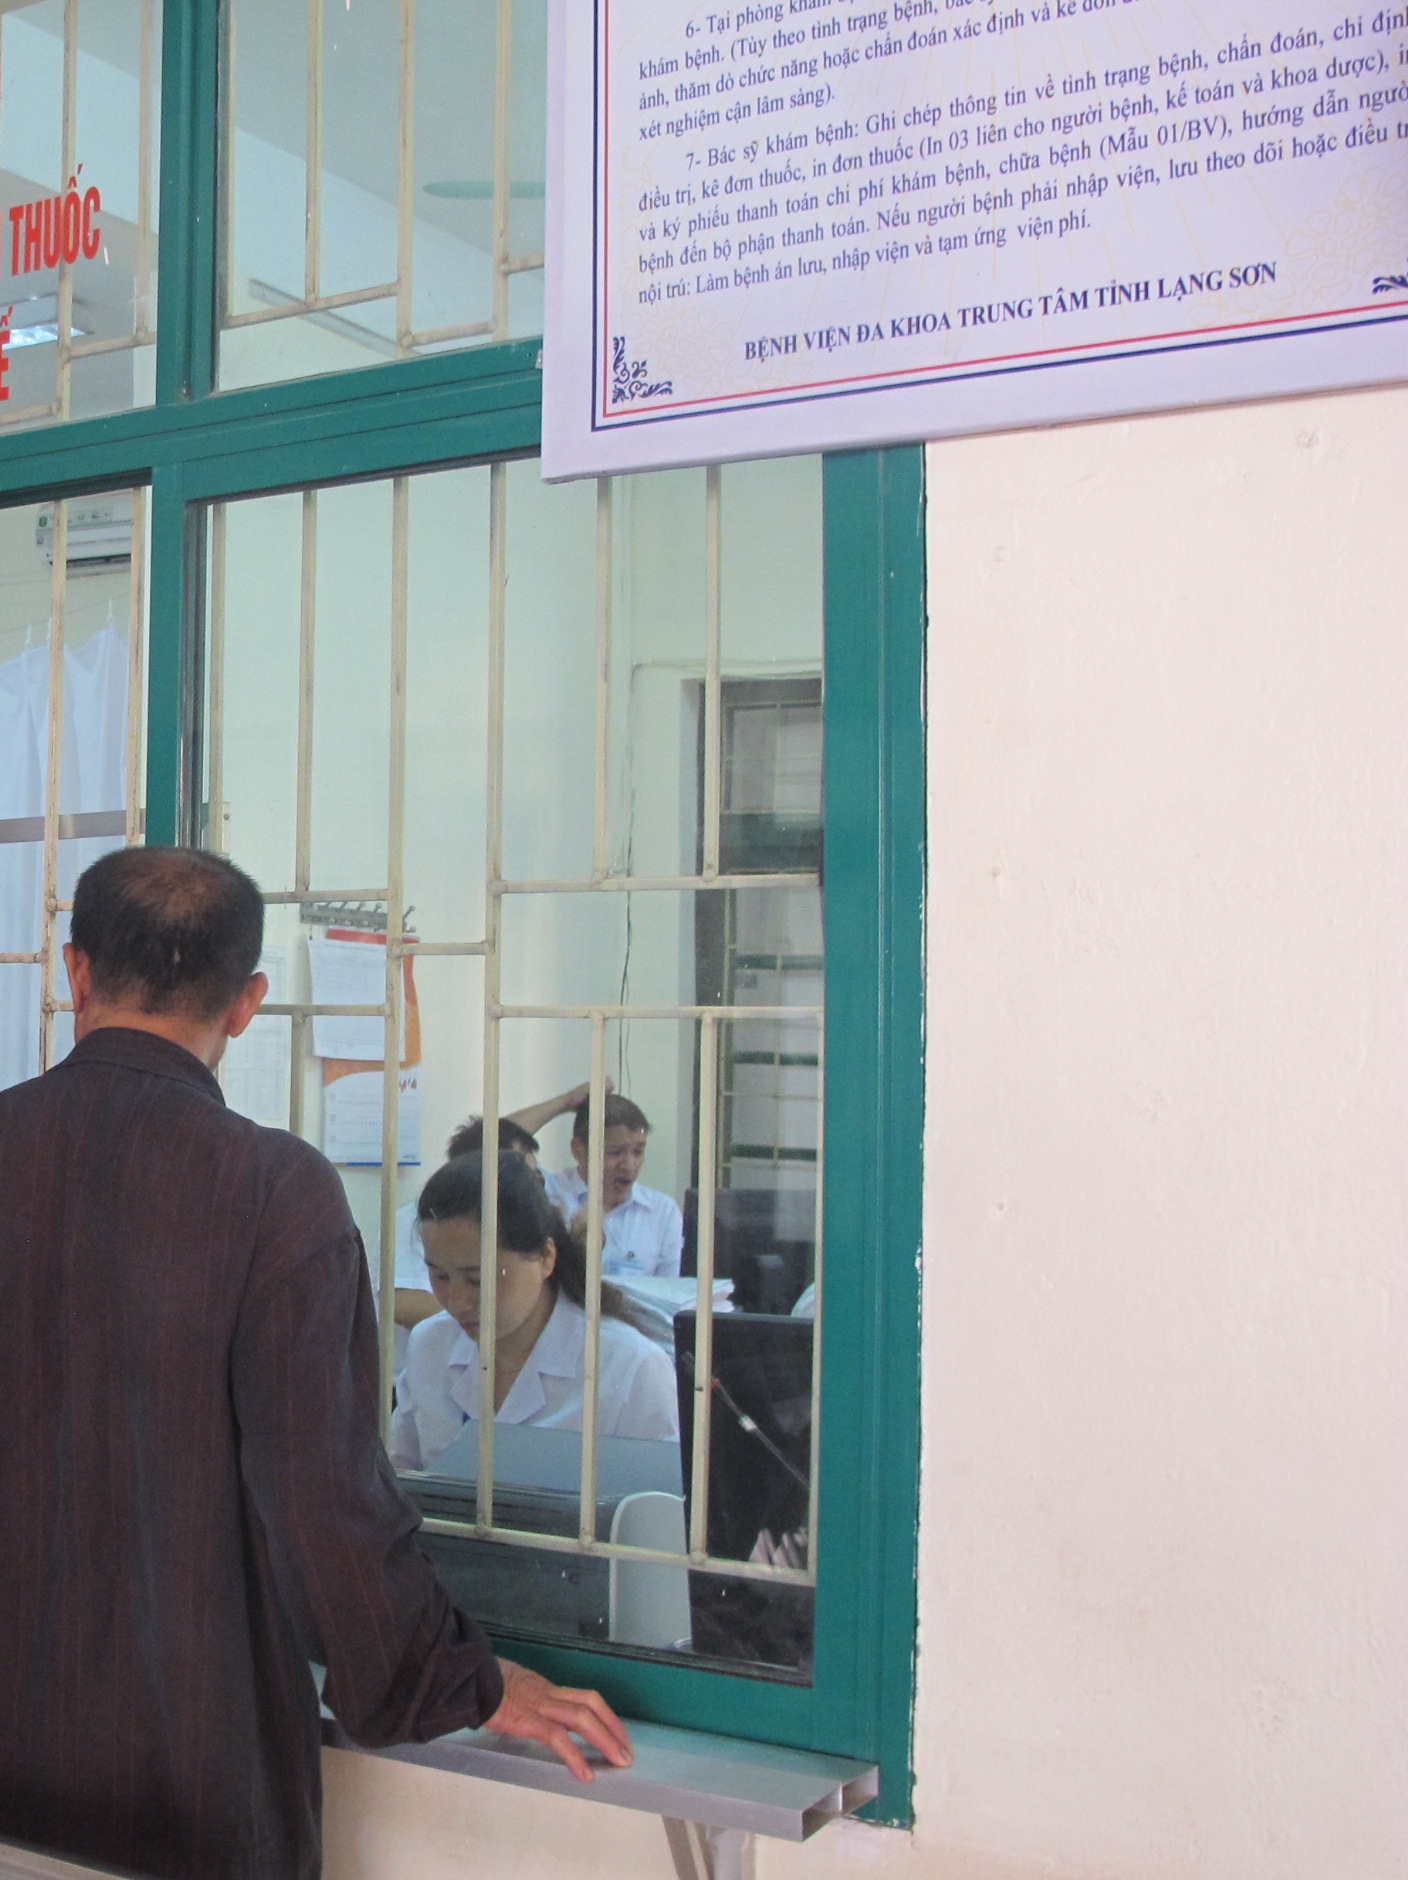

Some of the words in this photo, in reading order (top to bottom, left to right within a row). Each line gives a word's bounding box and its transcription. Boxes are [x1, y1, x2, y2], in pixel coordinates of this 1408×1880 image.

[638, 56, 680, 81] khám
[684, 44, 725, 72] bệnh.
[729, 35, 768, 62] (Tùy
[771, 28, 807, 50] theo
[810, 16, 842, 41] tình
[846, 10, 889, 34] trạng
[638, 87, 670, 112] ảnh,
[674, 81, 711, 103] thăm
[714, 71, 736, 94] dò
[738, 64, 776, 89] chức
[780, 58, 819, 80] năng
[822, 46, 860, 70] hoặc
[863, 30, 904, 61] chẩn
[906, 25, 948, 52] đoán
[952, 18, 982, 42] xác
[986, 7, 1025, 35] định
[1030, 1, 1051, 24] và
[684, 19, 702, 40] 6-
[705, 10, 731, 36] Tại
[735, 2, 785, 33] phòng
[637, 184, 671, 213] điều
[674, 182, 697, 207] trị,
[701, 178, 720, 200] kê
[723, 174, 754, 196] đơn
[758, 158, 807, 189] thuốc,
[812, 157, 828, 179] in
[831, 152, 864, 175] đơn
[868, 135, 914, 168] thuốc
[918, 135, 944, 161] (In
[948, 128, 970, 152] 03
[975, 123, 1008, 147] liên
[1012, 116, 1046, 140] cho
[1050, 101, 1103, 136] người
[1109, 92, 1160, 123] bệnh,
[1165, 79, 1188, 111] kế
[1193, 79, 1236, 106] toán
[1241, 71, 1265, 96] và
[1270, 65, 1319, 91] khoa
[1324, 49, 1390, 81] dược),
[638, 119, 662, 142] xét
[665, 108, 721, 139] nghiệm
[724, 100, 752, 125] cận
[756, 94, 785, 116] lâm
[789, 82, 836, 109] sàng).
[685, 151, 702, 171] 7-
[707, 144, 737, 168] Bác
[742, 139, 760, 164] sỹ
[765, 131, 809, 156] khám
[814, 119, 859, 147] bệnh:
[865, 109, 897, 135] Ghi
[902, 102, 943, 128] chép
[948, 93, 998, 119] thông
[1003, 85, 1027, 108] tin
[1034, 72, 1056, 101] về
[1061, 69, 1097, 96] tình
[1103, 64, 1151, 89] trạng
[1157, 48, 1209, 79] bệnh,
[1216, 32, 1263, 66] chẩn
[1269, 26, 1325, 55] đoán,
[8, 162, 103, 277] THUỐC
[638, 221, 657, 242] và
[662, 216, 682, 242] ký
[687, 203, 730, 239] phiếu
[735, 197, 779, 224] thanh
[785, 191, 820, 215] toán
[825, 183, 851, 208] chi
[857, 177, 884, 208] phí
[891, 170, 937, 196] khám
[944, 158, 992, 188] bệnh,
[998, 151, 1041, 176] chữa
[1048, 138, 1092, 169] bệnh
[1098, 125, 1149, 161] (Mẫu
[1156, 114, 1233, 147] 01/BV),
[1241, 103, 1305, 132] hướng
[1311, 88, 1350, 119] dẫn
[638, 249, 675, 276] bệnh
[678, 239, 708, 266] đến
[712, 238, 733, 262] bộ
[737, 232, 776, 261] phận
[781, 221, 825, 248] thanh
[830, 215, 871, 239] toán.
[876, 201, 911, 231] Nếu
[916, 195, 966, 228] người
[972, 187, 1014, 216] bệnh
[1020, 178, 1059, 212] phải
[1065, 172, 1110, 199] nhập
[1115, 163, 1161, 190] viện,
[1168, 157, 1199, 180] lưu
[1205, 150, 1247, 174] theo
[1252, 138, 1284, 166] dõi
[1291, 132, 1338, 160] hoặc
[1344, 116, 1389, 150] điều
[638, 281, 662, 306] nội
[665, 277, 691, 300] trú:
[695, 272, 730, 294] Làm
[733, 263, 770, 290] bệnh
[773, 260, 793, 281] án
[797, 256, 828, 277] lưu,
[831, 247, 871, 272] nhập
[874, 240, 910, 265] viện
[914, 234, 934, 256] và
[937, 233, 969, 256] tạm
[973, 225, 1008, 249] ứng
[1016, 215, 1054, 241] viện
[1058, 207, 1092, 239] phí.
[744, 333, 798, 364] BỆNH
[802, 325, 852, 354] VIỆN
[855, 321, 886, 345] ĐA
[889, 311, 953, 339] KHOA
[956, 297, 1034, 329] TRUNG
[1037, 286, 1090, 317] TÂM
[1093, 278, 1151, 309] TỈNH
[1156, 269, 1224, 303] LẠNG
[1228, 260, 1278, 290] SƠN
